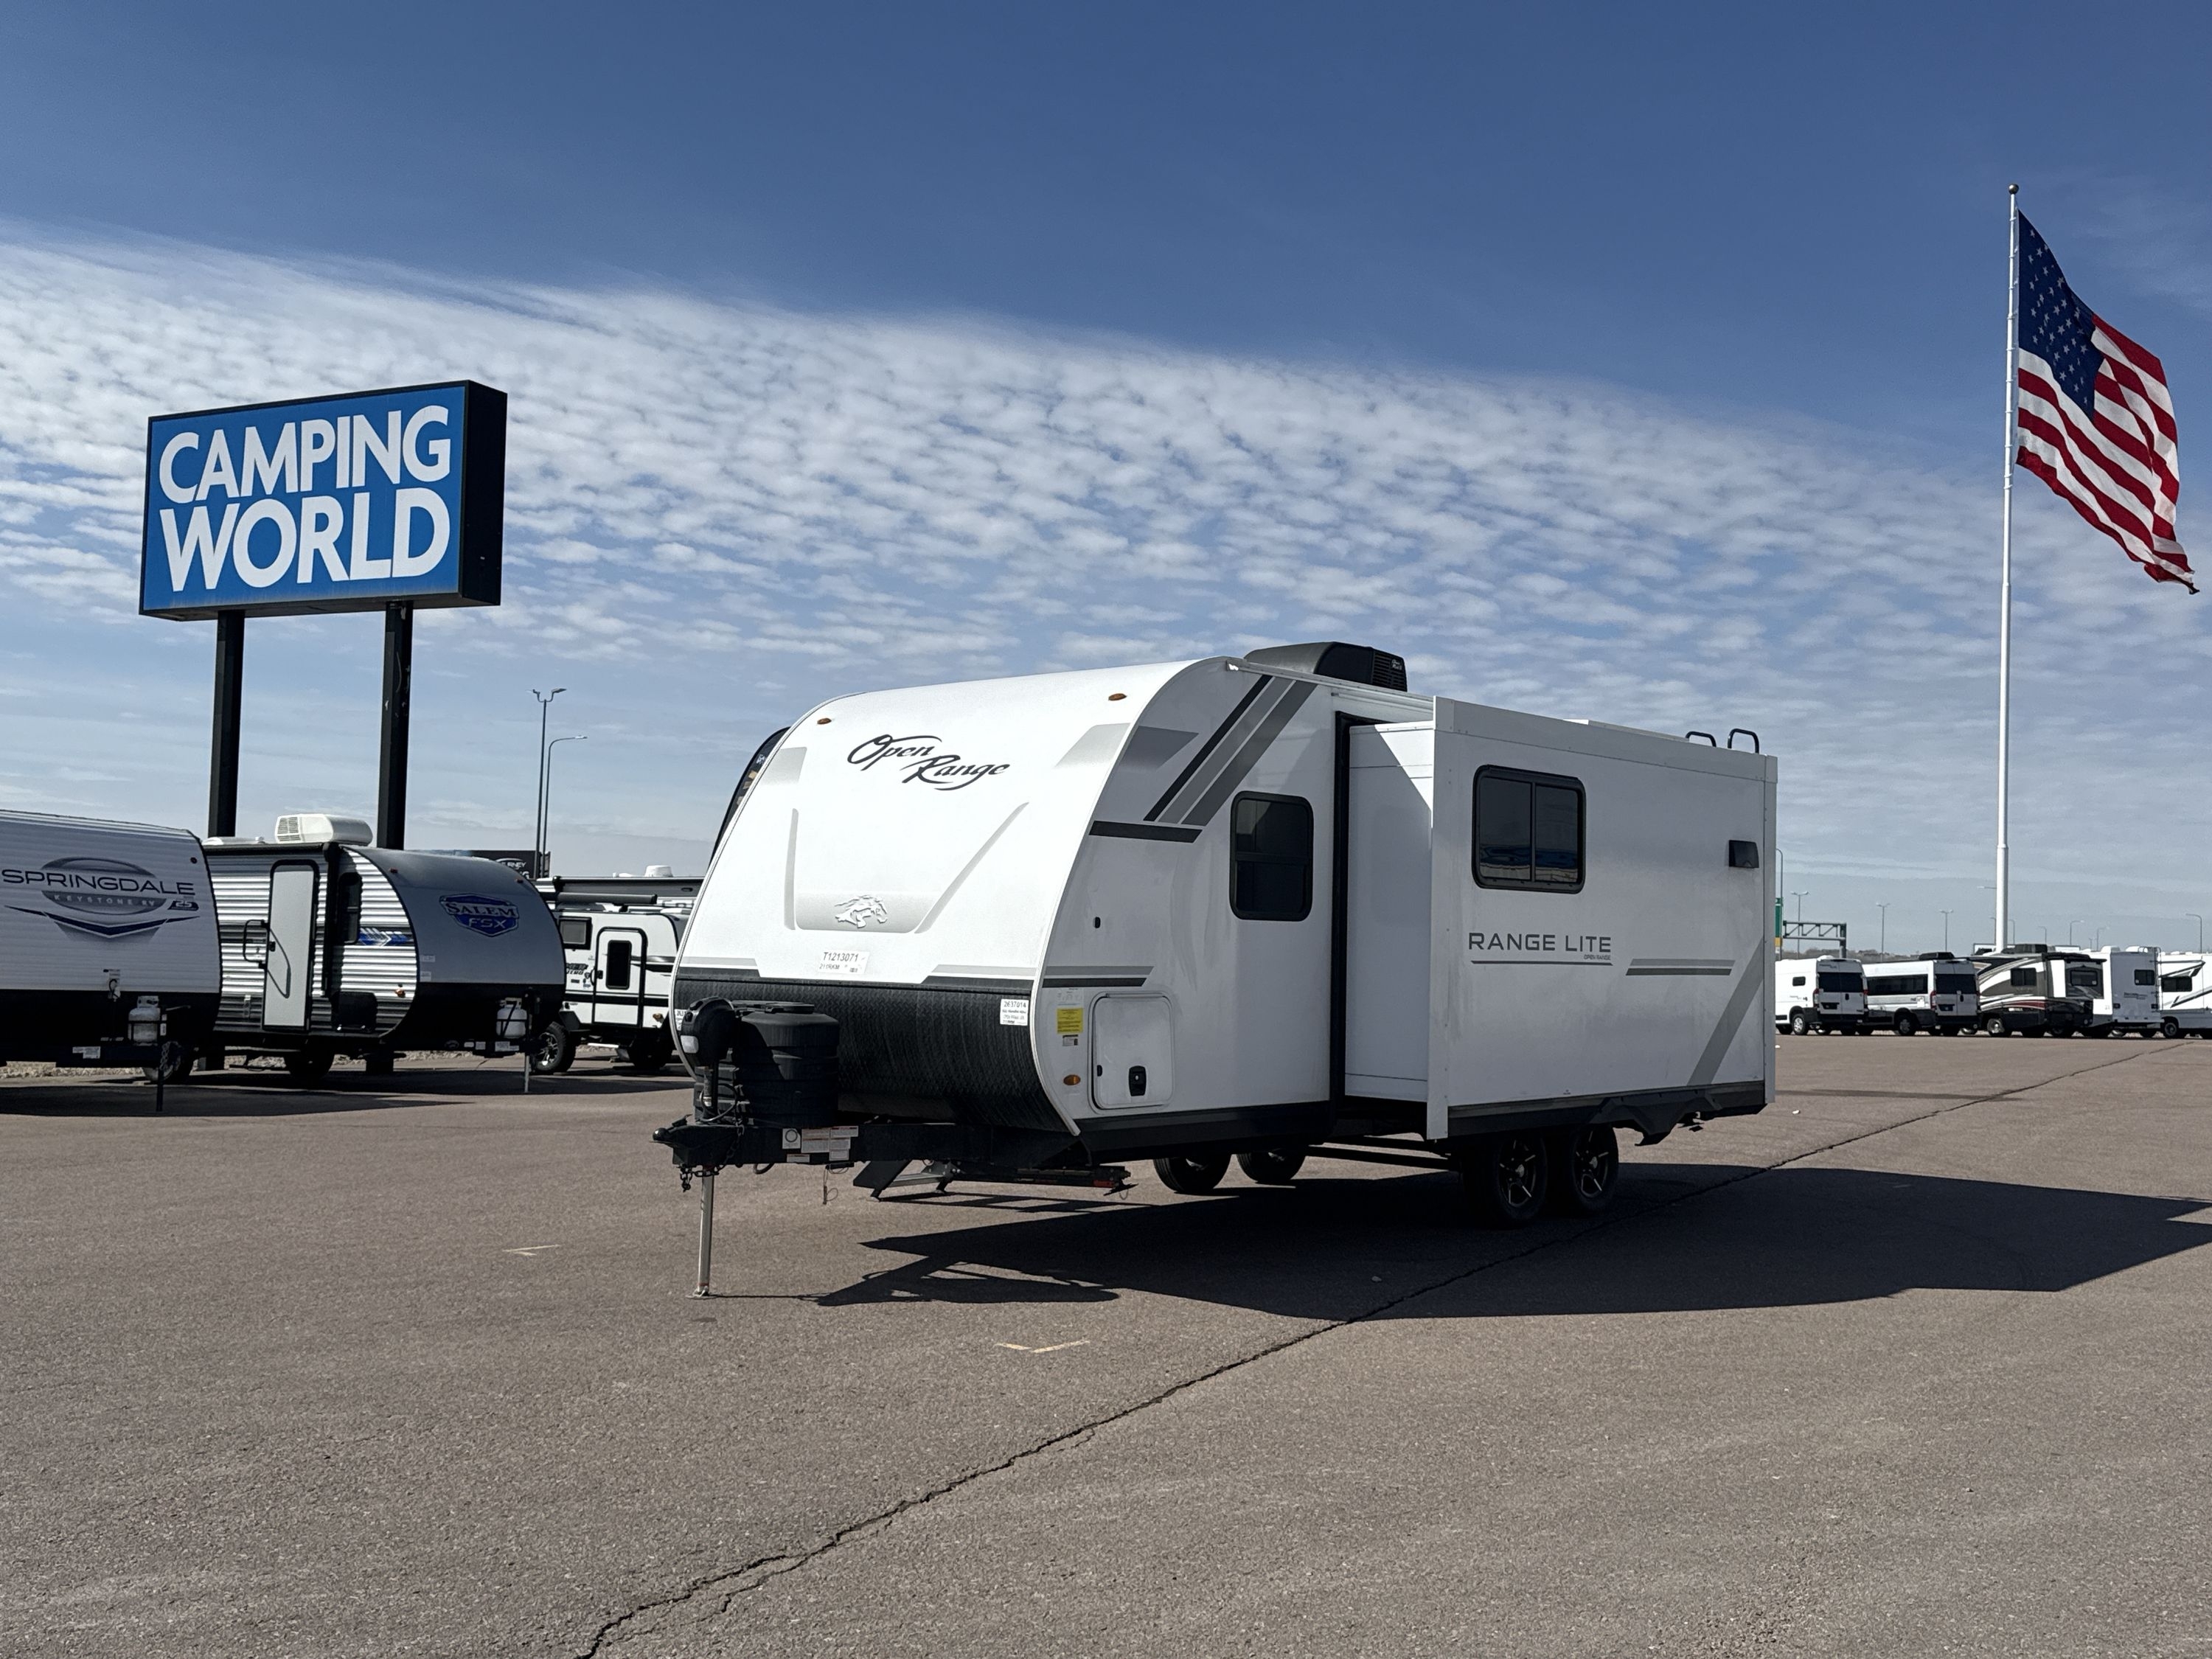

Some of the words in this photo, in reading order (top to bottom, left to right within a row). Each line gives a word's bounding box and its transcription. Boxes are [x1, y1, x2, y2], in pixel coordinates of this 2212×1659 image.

[159, 405, 451, 504] CAMPING
[159, 487, 451, 592] WORLD
[847, 734, 942, 771] Open
[900, 754, 1010, 791] Range
[1, 869, 195, 895] SPRINGDALE
[54, 894, 133, 905] KEYSTONE
[445, 902, 516, 917] SALEM
[469, 918, 507, 928] FSX
[1469, 932, 1555, 951] RANGE
[1565, 935, 1611, 953] LITE
[824, 952, 859, 962] T1213071
